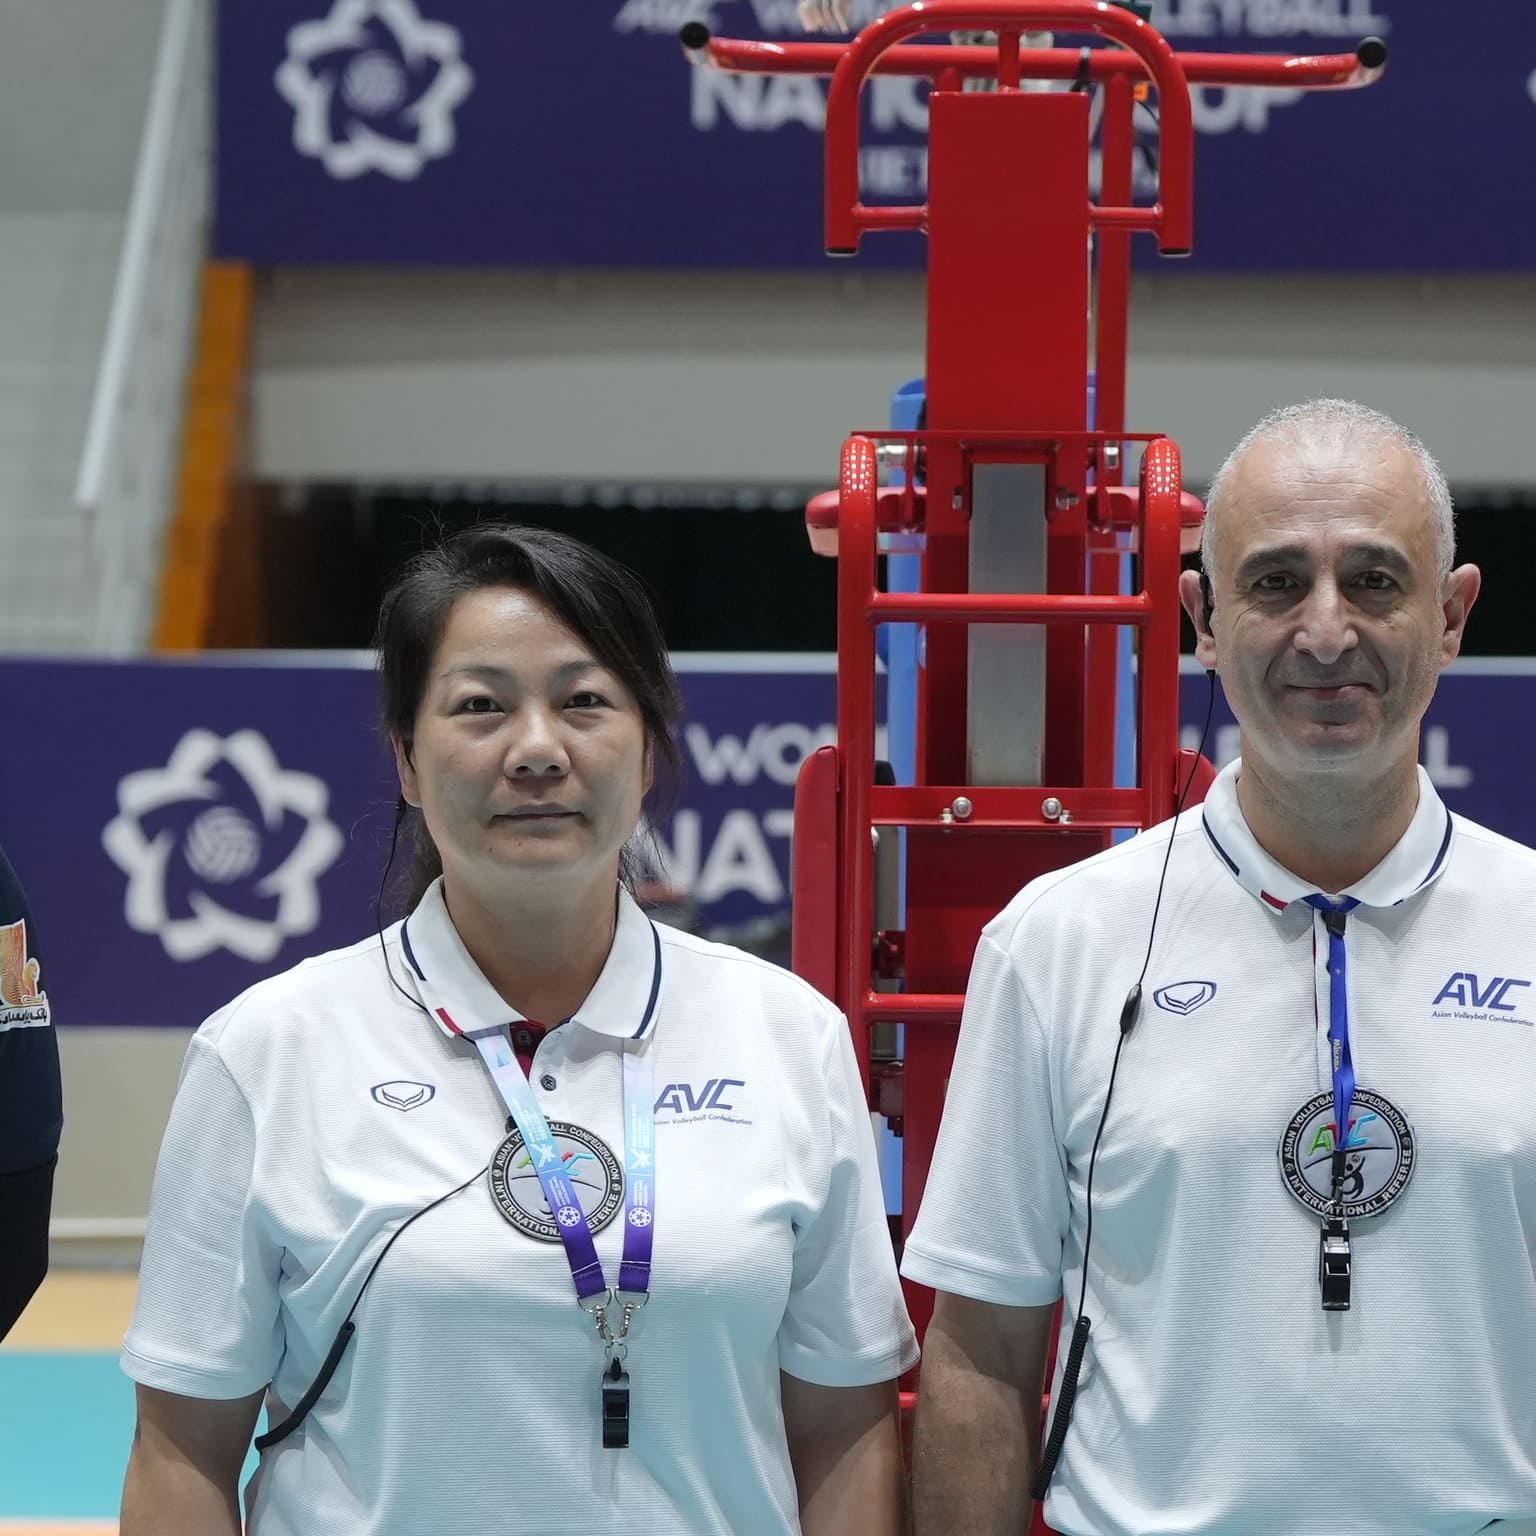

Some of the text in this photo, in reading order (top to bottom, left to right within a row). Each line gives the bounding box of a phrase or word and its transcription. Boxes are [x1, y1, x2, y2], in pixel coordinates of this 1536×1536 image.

[1432, 972, 1532, 1011] AVC
[1432, 1010, 1534, 1027] Asian Volleyball Confederation
[654, 1079, 745, 1114] AVC
[1285, 1092, 1407, 1158] ASIAN VOLLEYBA ONFEDERATION
[498, 1142, 514, 1166] ASIAN
[569, 1126, 621, 1180] CONFEDERATION
[1382, 1150, 1412, 1201] REFEREE
[494, 1181, 561, 1235] INTERNATION
[585, 1193, 619, 1228] EFEREE
